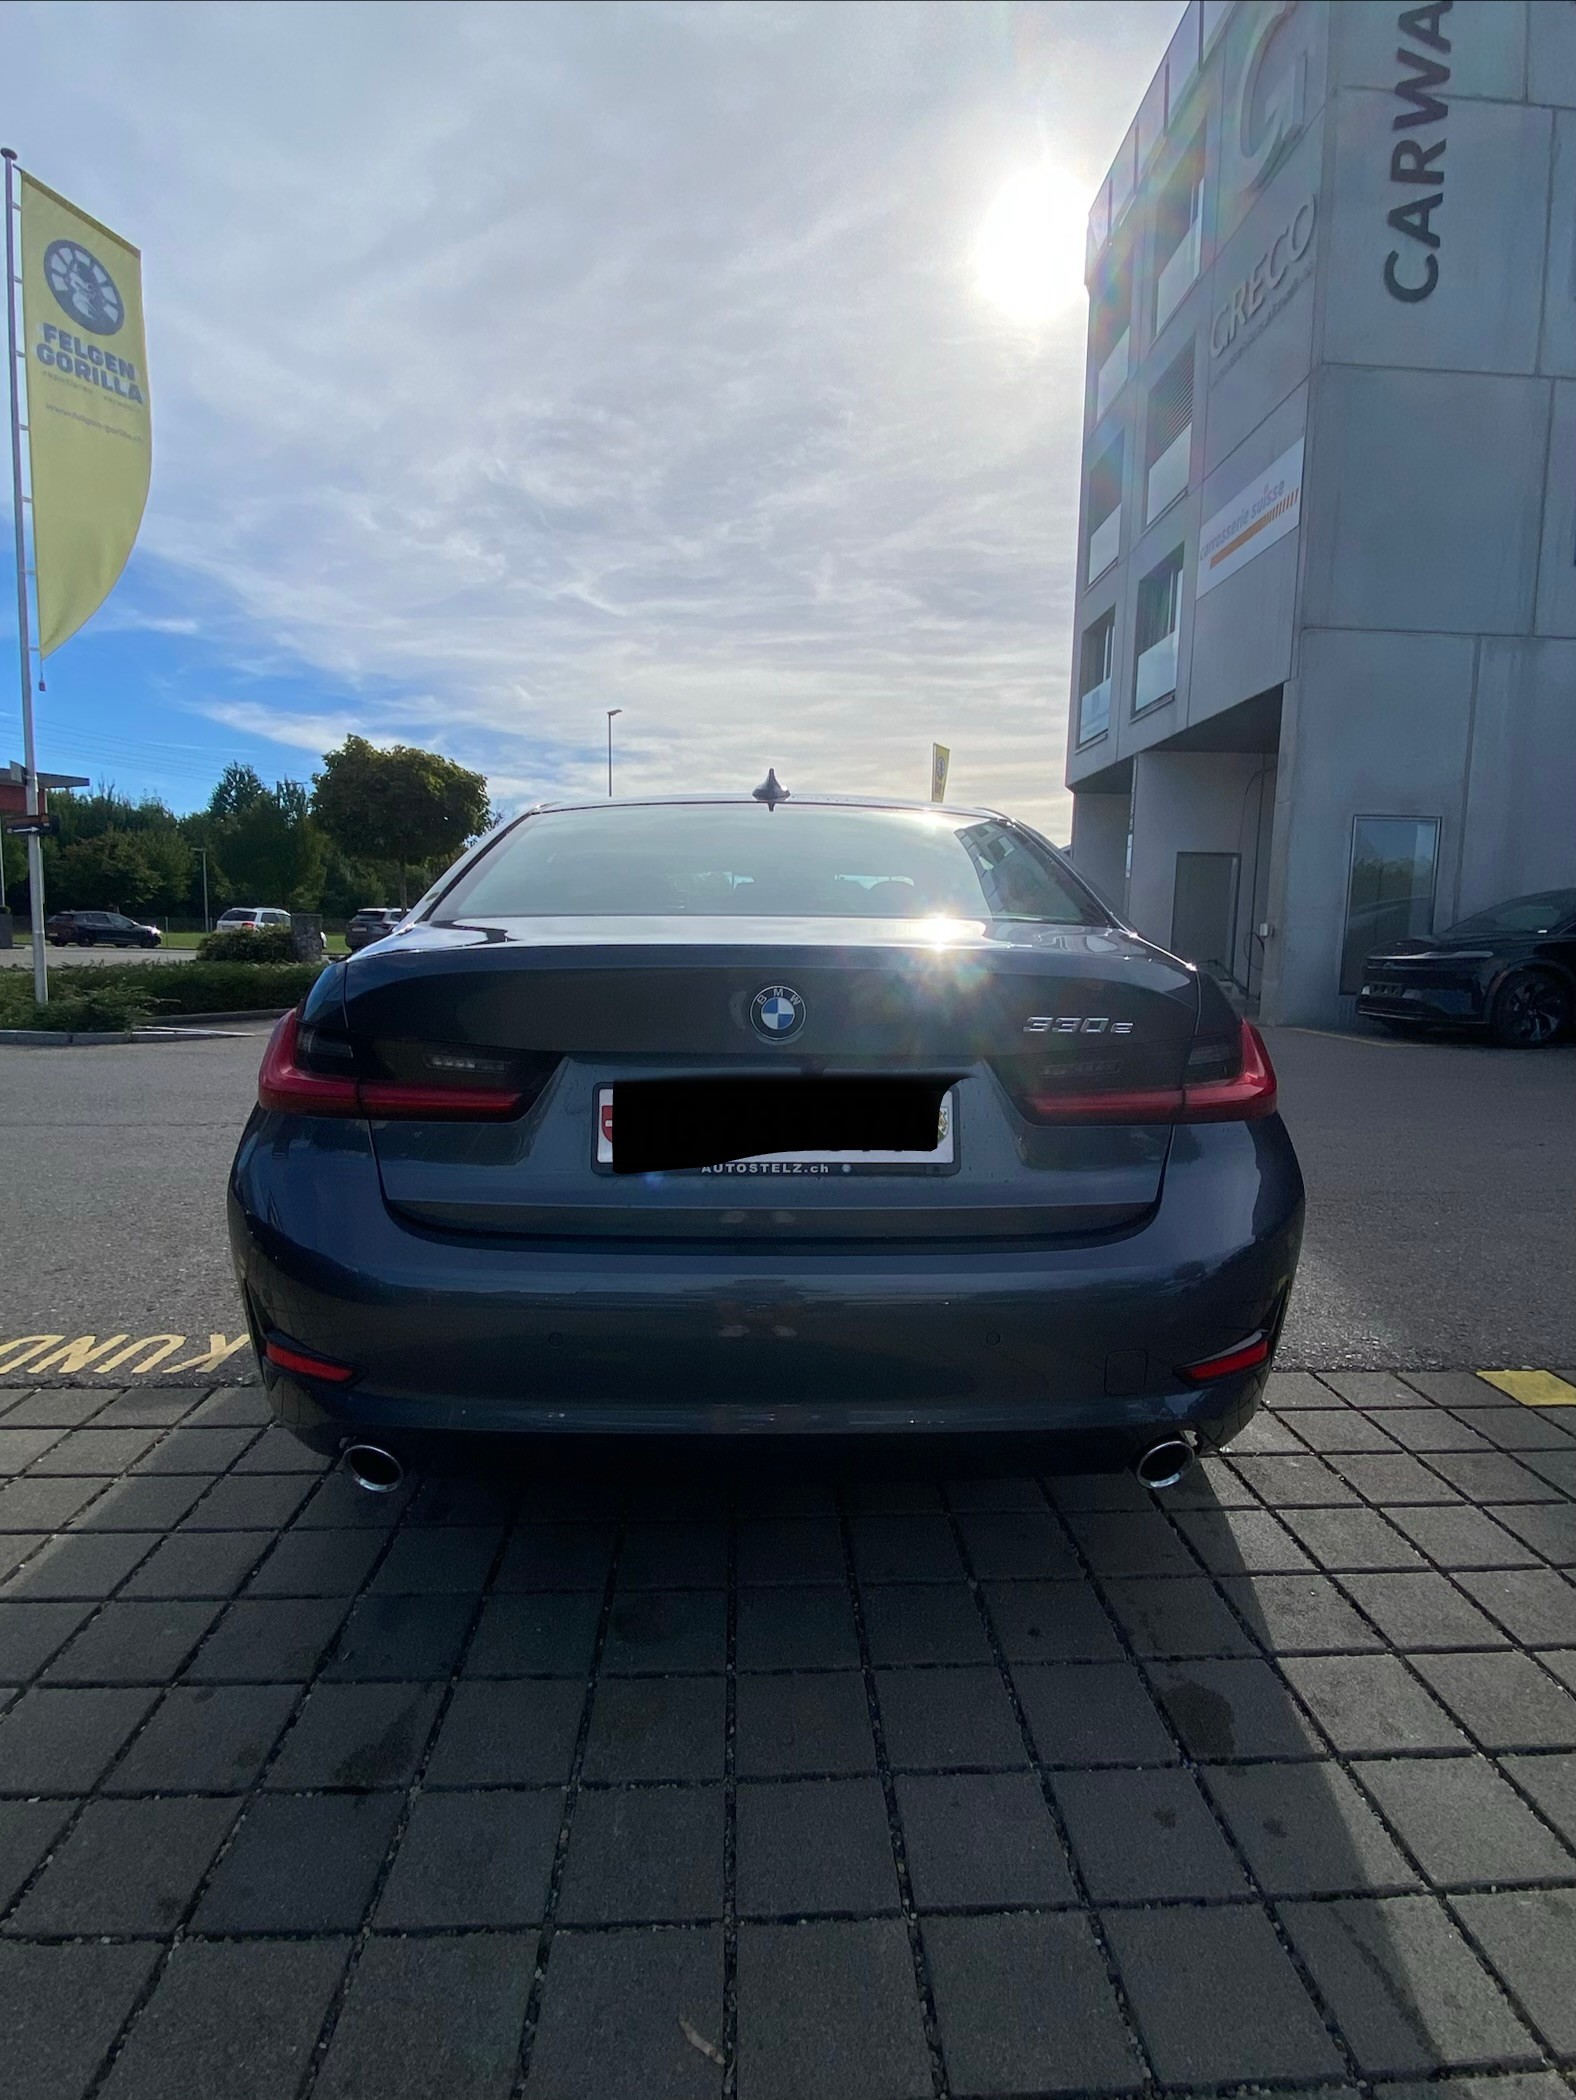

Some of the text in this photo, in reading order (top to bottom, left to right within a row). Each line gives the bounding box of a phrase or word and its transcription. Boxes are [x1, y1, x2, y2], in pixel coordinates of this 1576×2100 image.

[1210, 193, 1316, 358] GRECO
[36, 343, 144, 404] GORILLA
[42, 322, 136, 381] FELGEN
[1200, 480, 1285, 561] carrosserie suisse
[757, 988, 801, 1006] BMW
[701, 1163, 830, 1174] AUTOSTELZ.ch
